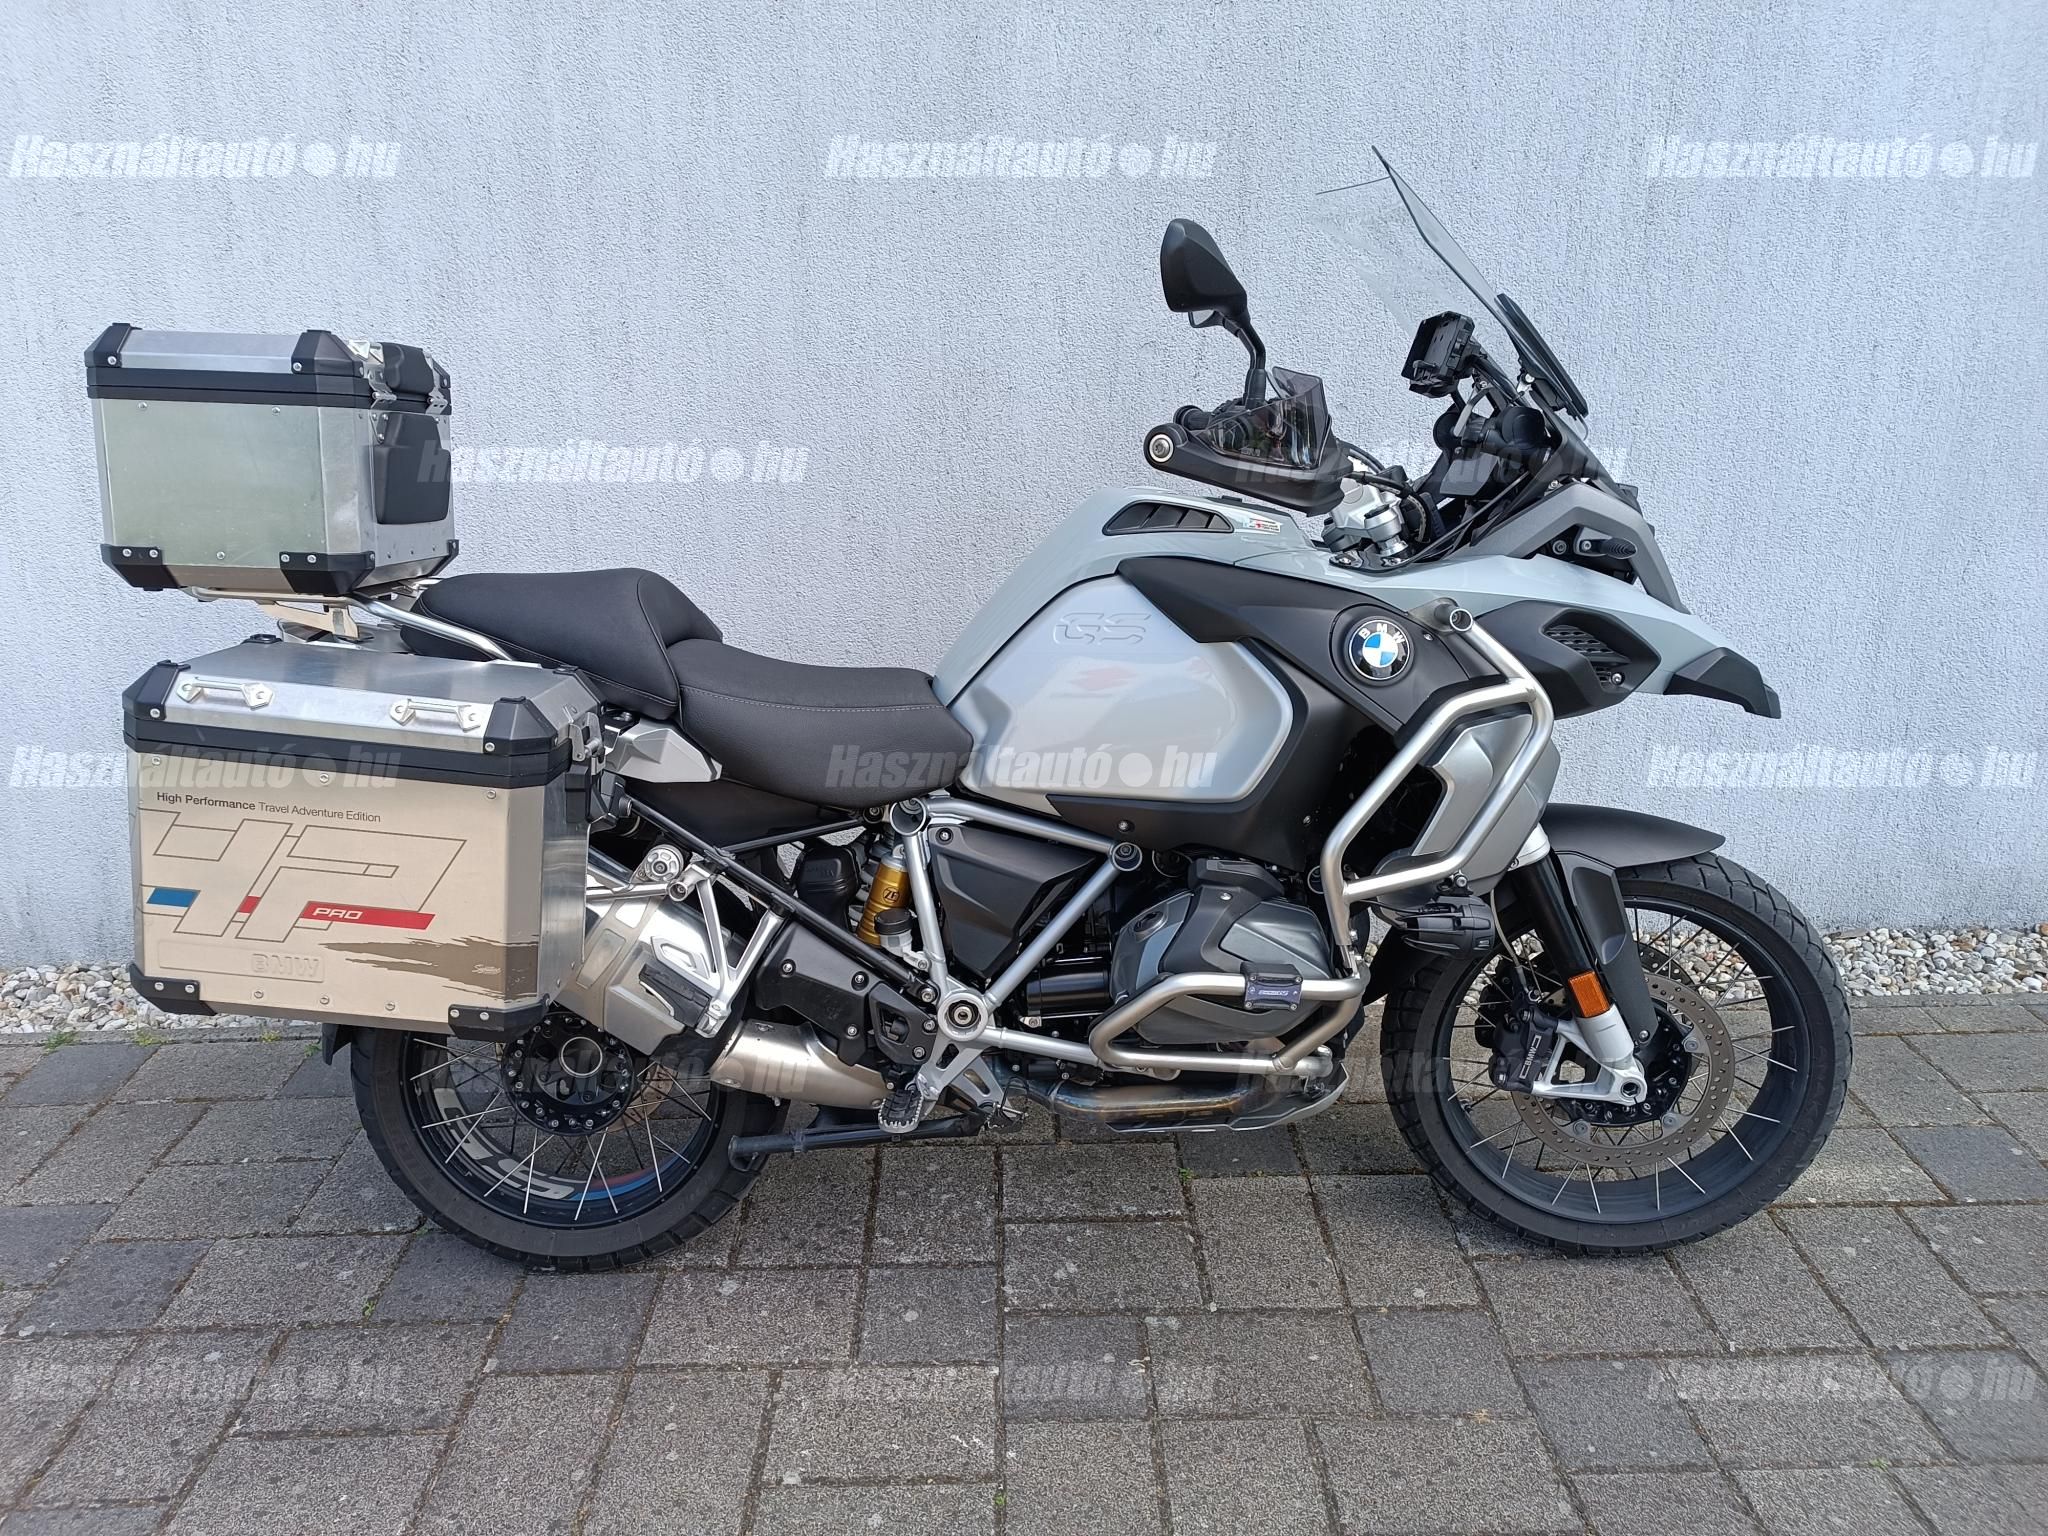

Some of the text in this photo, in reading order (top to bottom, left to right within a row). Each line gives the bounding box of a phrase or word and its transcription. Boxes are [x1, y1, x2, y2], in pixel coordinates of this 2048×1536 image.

[1053, 612, 1152, 645] GS
[1358, 622, 1405, 644] BMW
[156, 791, 382, 823] High Performance Travel Adventure Edition
[884, 889, 900, 902] ZF
[312, 906, 364, 921] PRO
[250, 953, 320, 978] BMW
[1524, 1046, 1537, 1066] BMW
